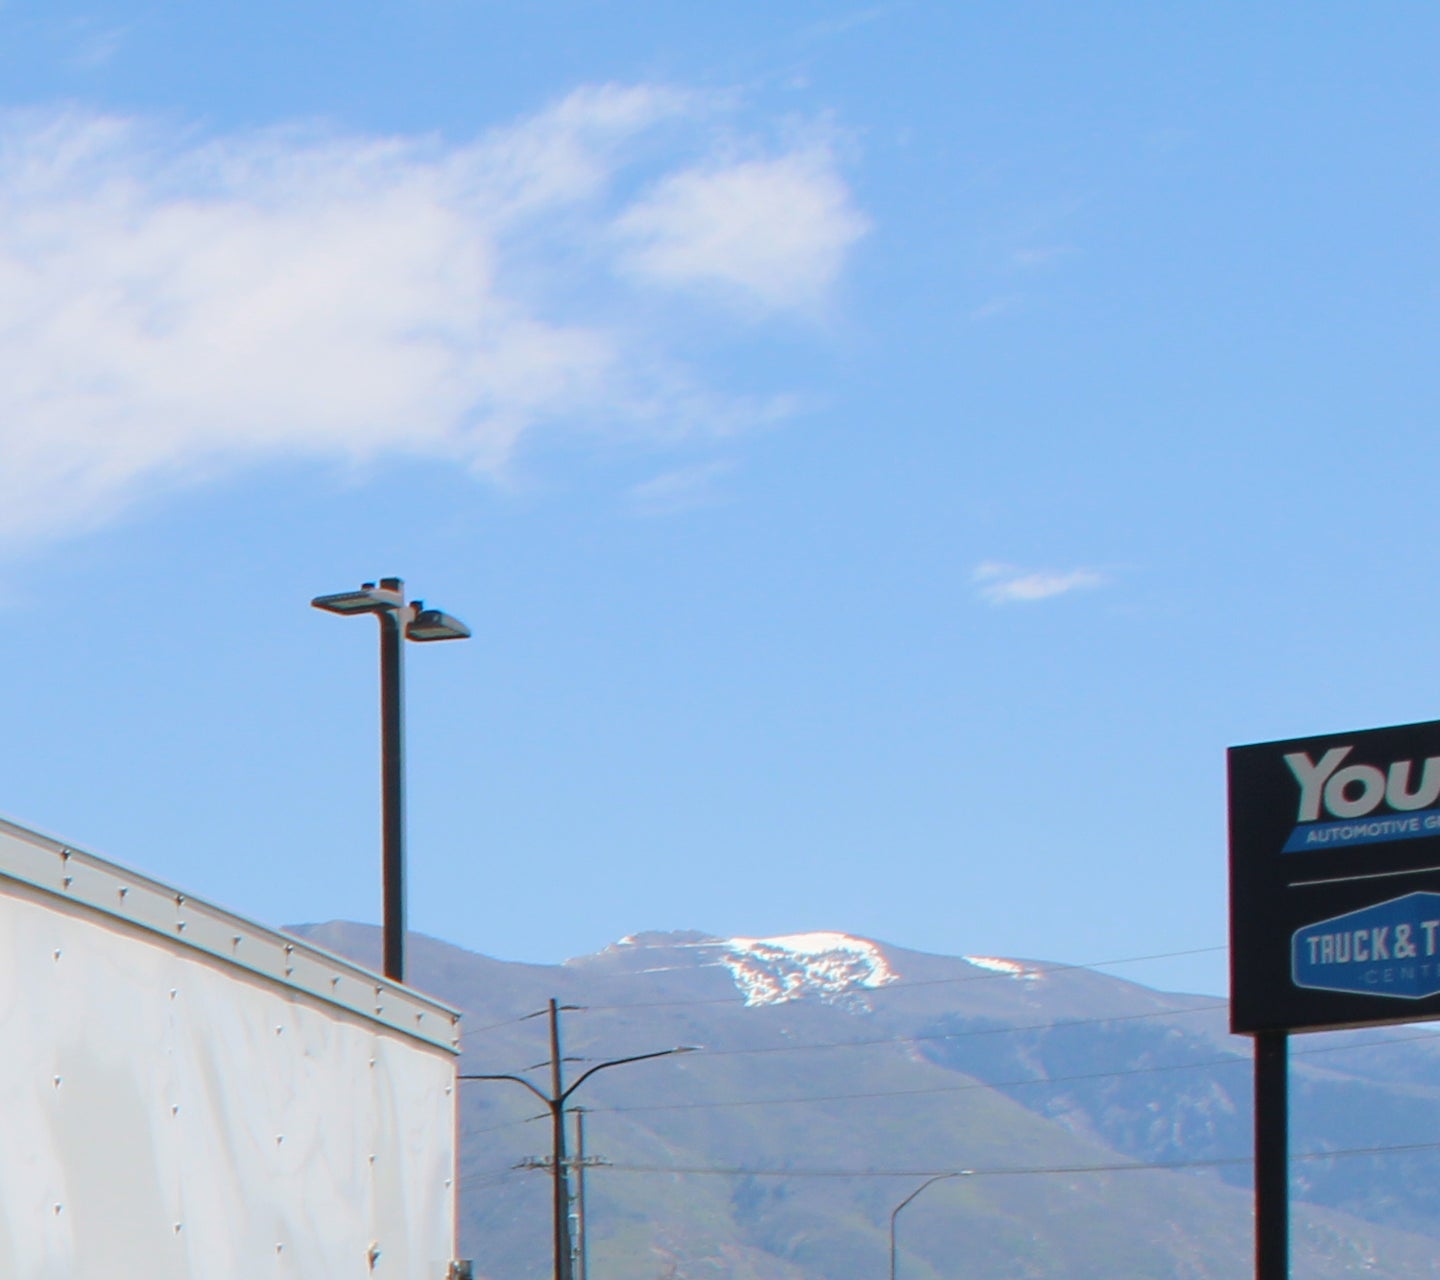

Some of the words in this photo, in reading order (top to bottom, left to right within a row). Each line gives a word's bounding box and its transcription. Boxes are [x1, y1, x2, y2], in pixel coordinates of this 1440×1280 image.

[1306, 816, 1420, 844] AUTOMOTIVE
[1306, 926, 1390, 965] TRUCK
[1393, 923, 1417, 960] &
